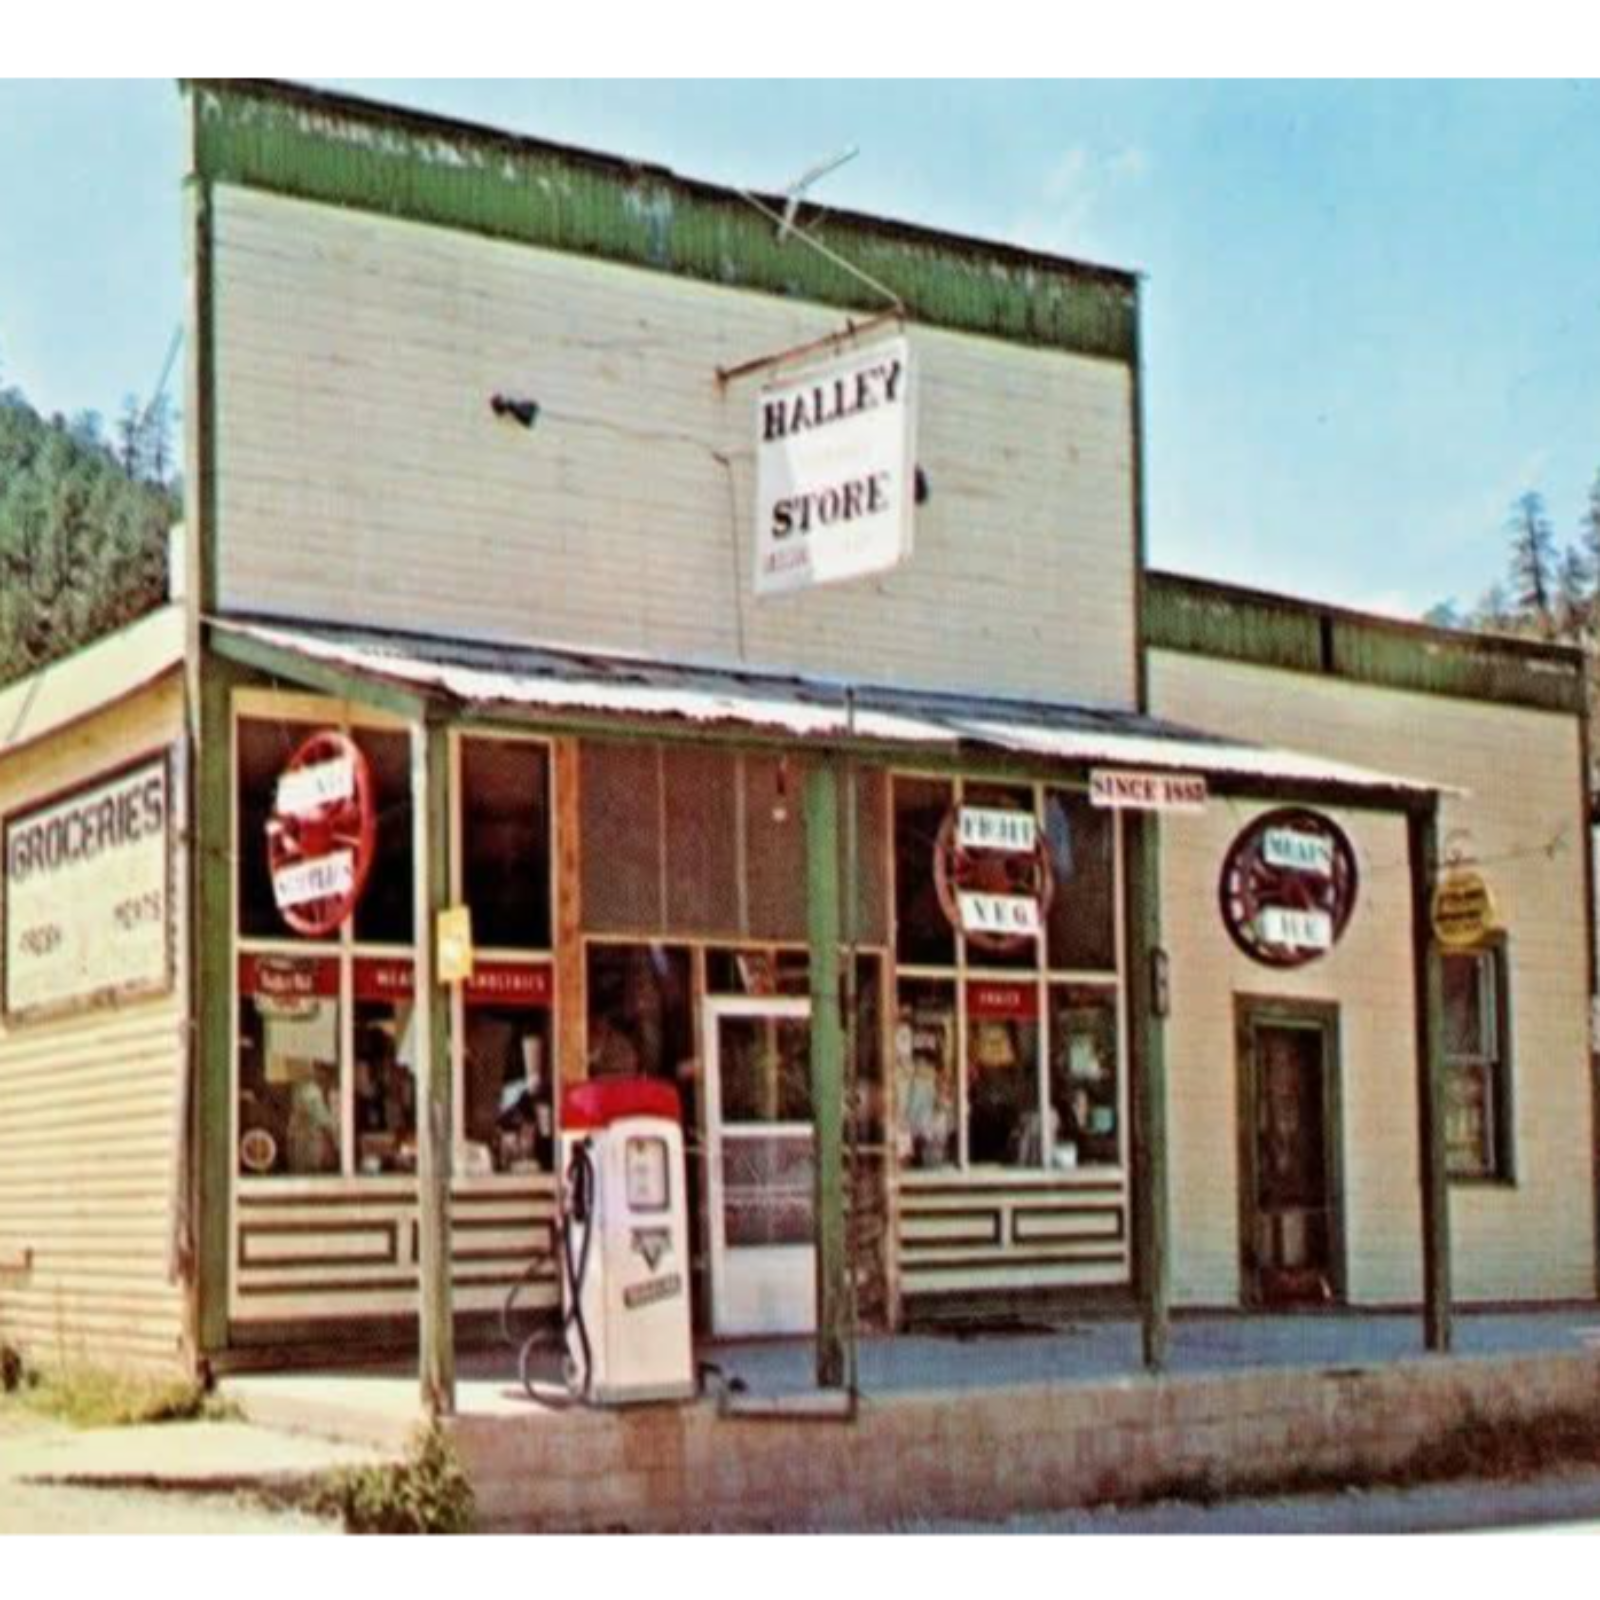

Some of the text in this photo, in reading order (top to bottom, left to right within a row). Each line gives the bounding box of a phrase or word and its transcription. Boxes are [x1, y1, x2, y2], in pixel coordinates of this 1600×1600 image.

[763, 360, 901, 442] HALLEY
[771, 470, 890, 540] STORE
[1094, 775, 1156, 801] SINCE
[9, 777, 163, 882] GROCERIES
[973, 898, 1028, 926] VEG
